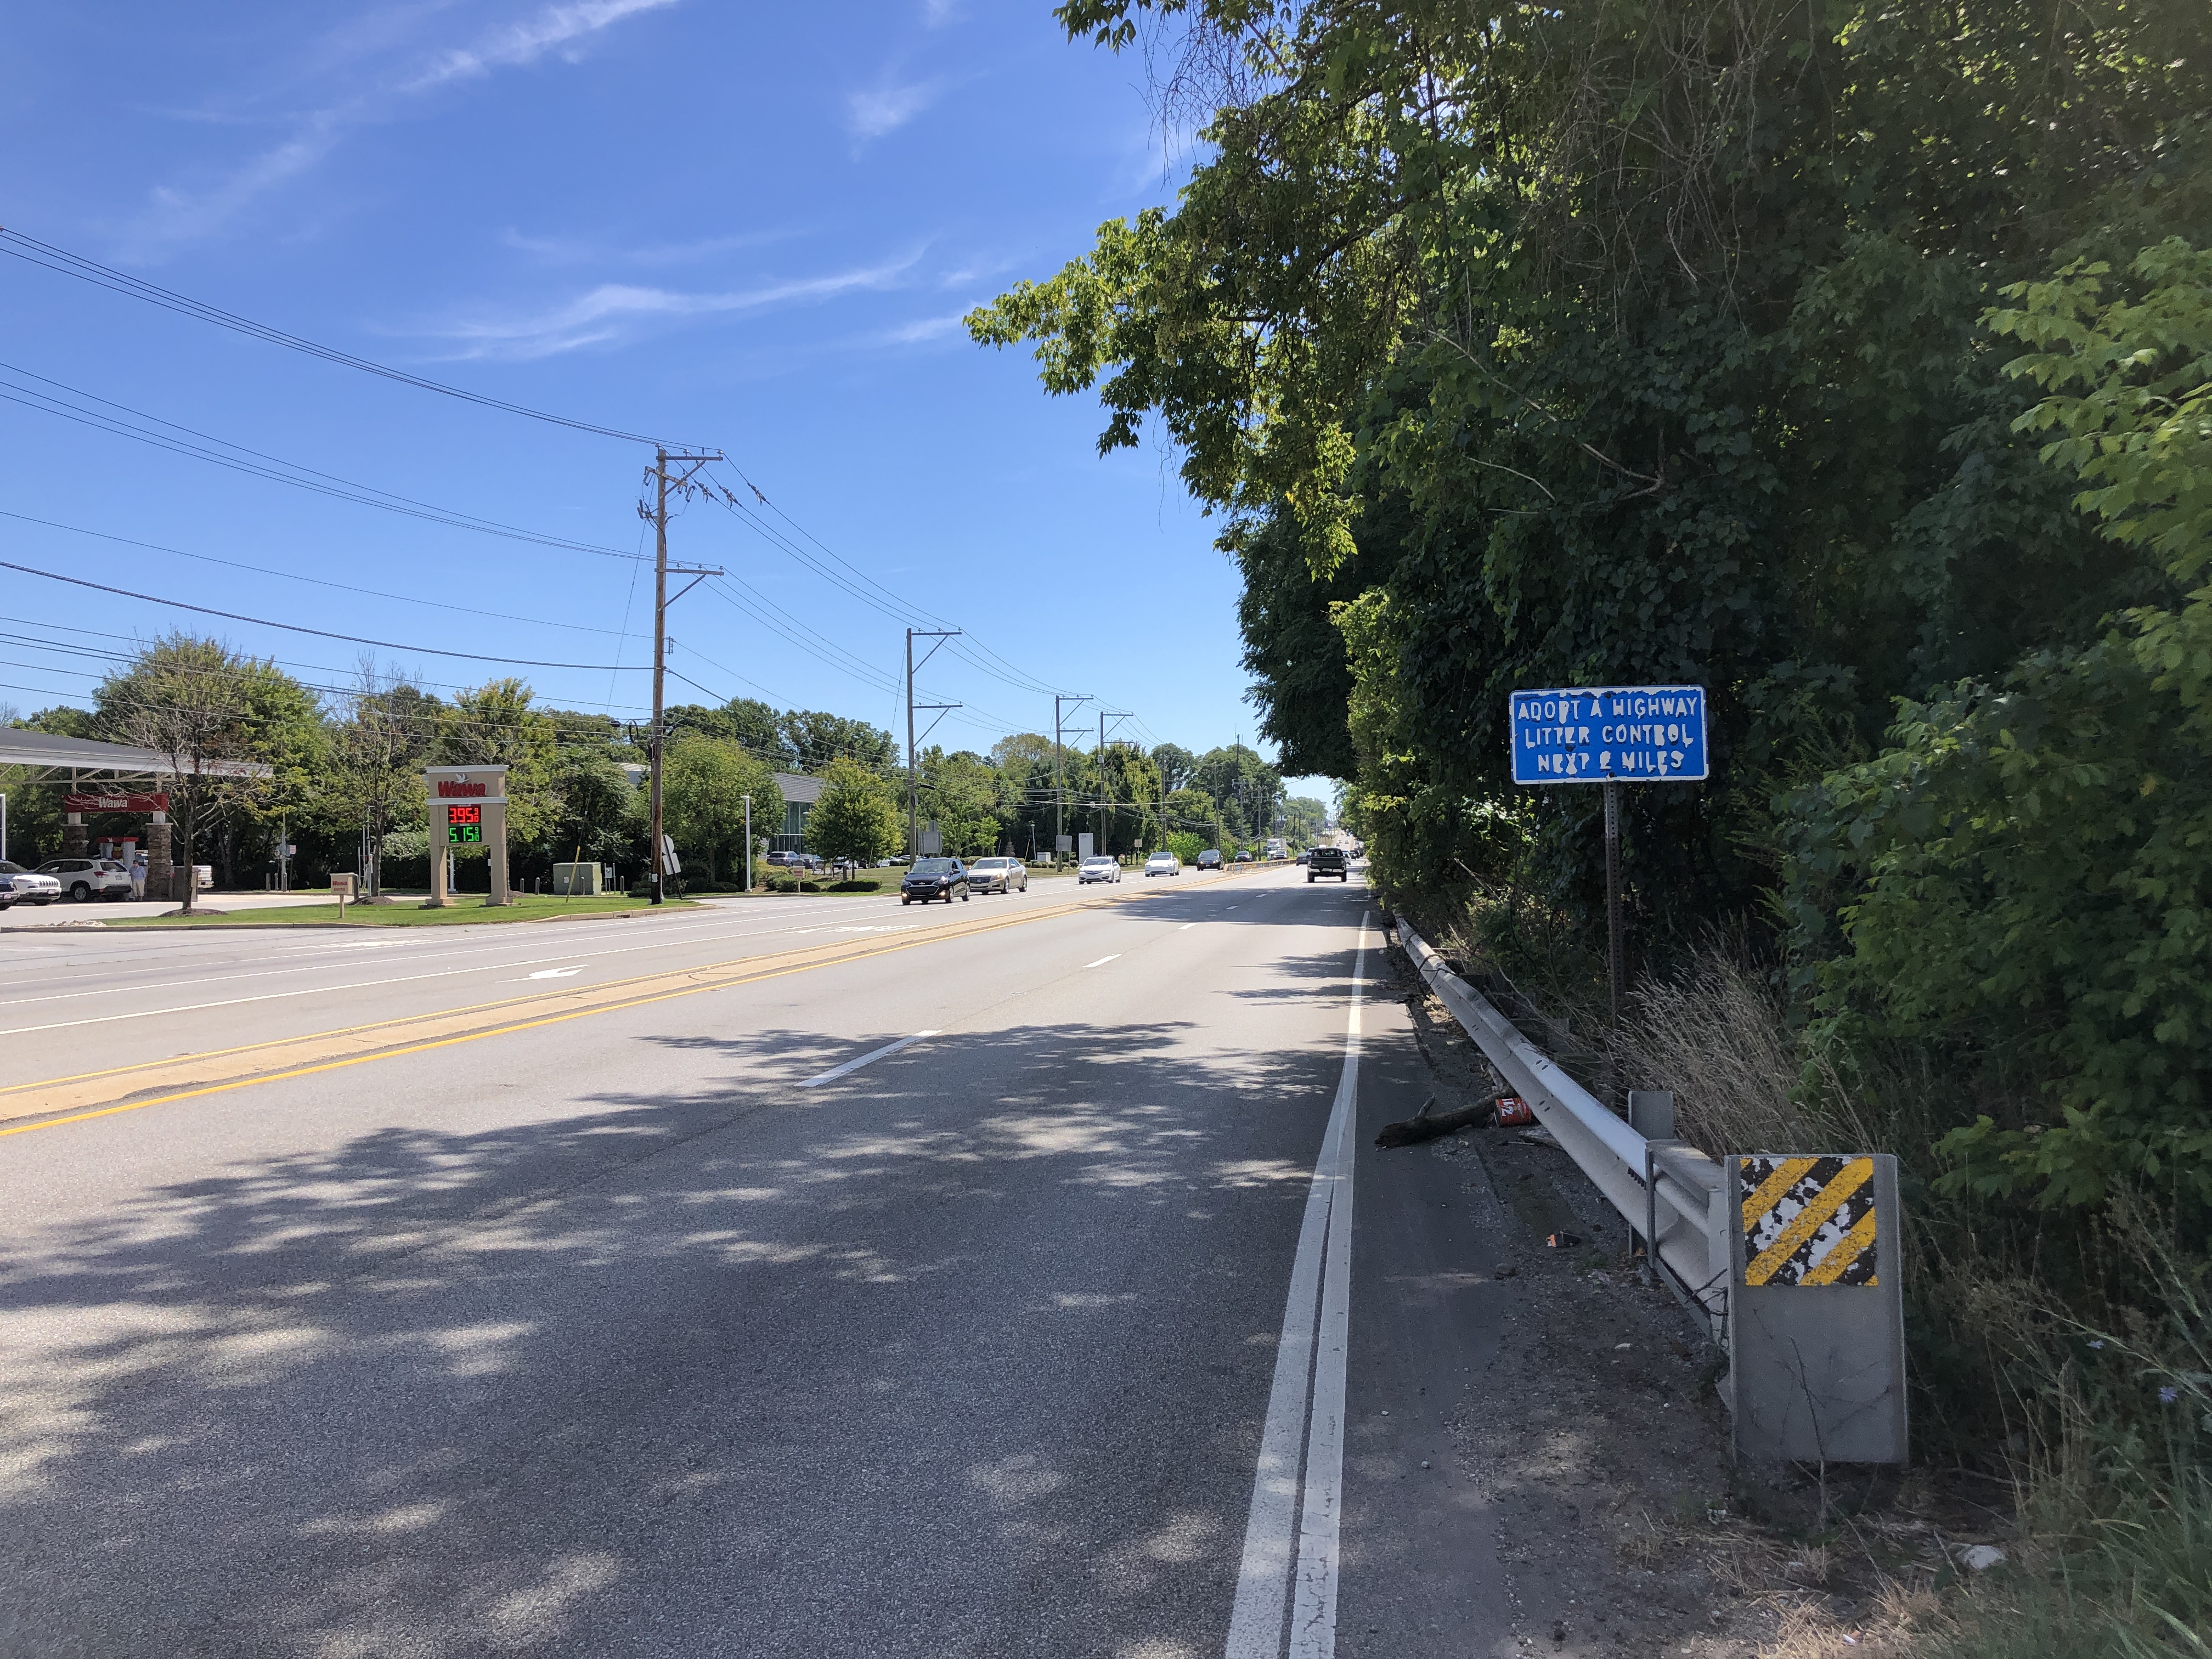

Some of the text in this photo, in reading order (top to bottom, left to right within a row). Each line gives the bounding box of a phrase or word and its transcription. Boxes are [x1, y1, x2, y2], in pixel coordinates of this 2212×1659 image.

[1518, 697, 1697, 723] ADOPT A HIGHWAY
[1525, 724, 1694, 748] LITTER CONTROL
[1538, 753, 1589, 775] NEXT
[1622, 751, 1684, 776] MILES
[437, 781, 487, 797] Wawa
[98, 797, 128, 808] Wawa
